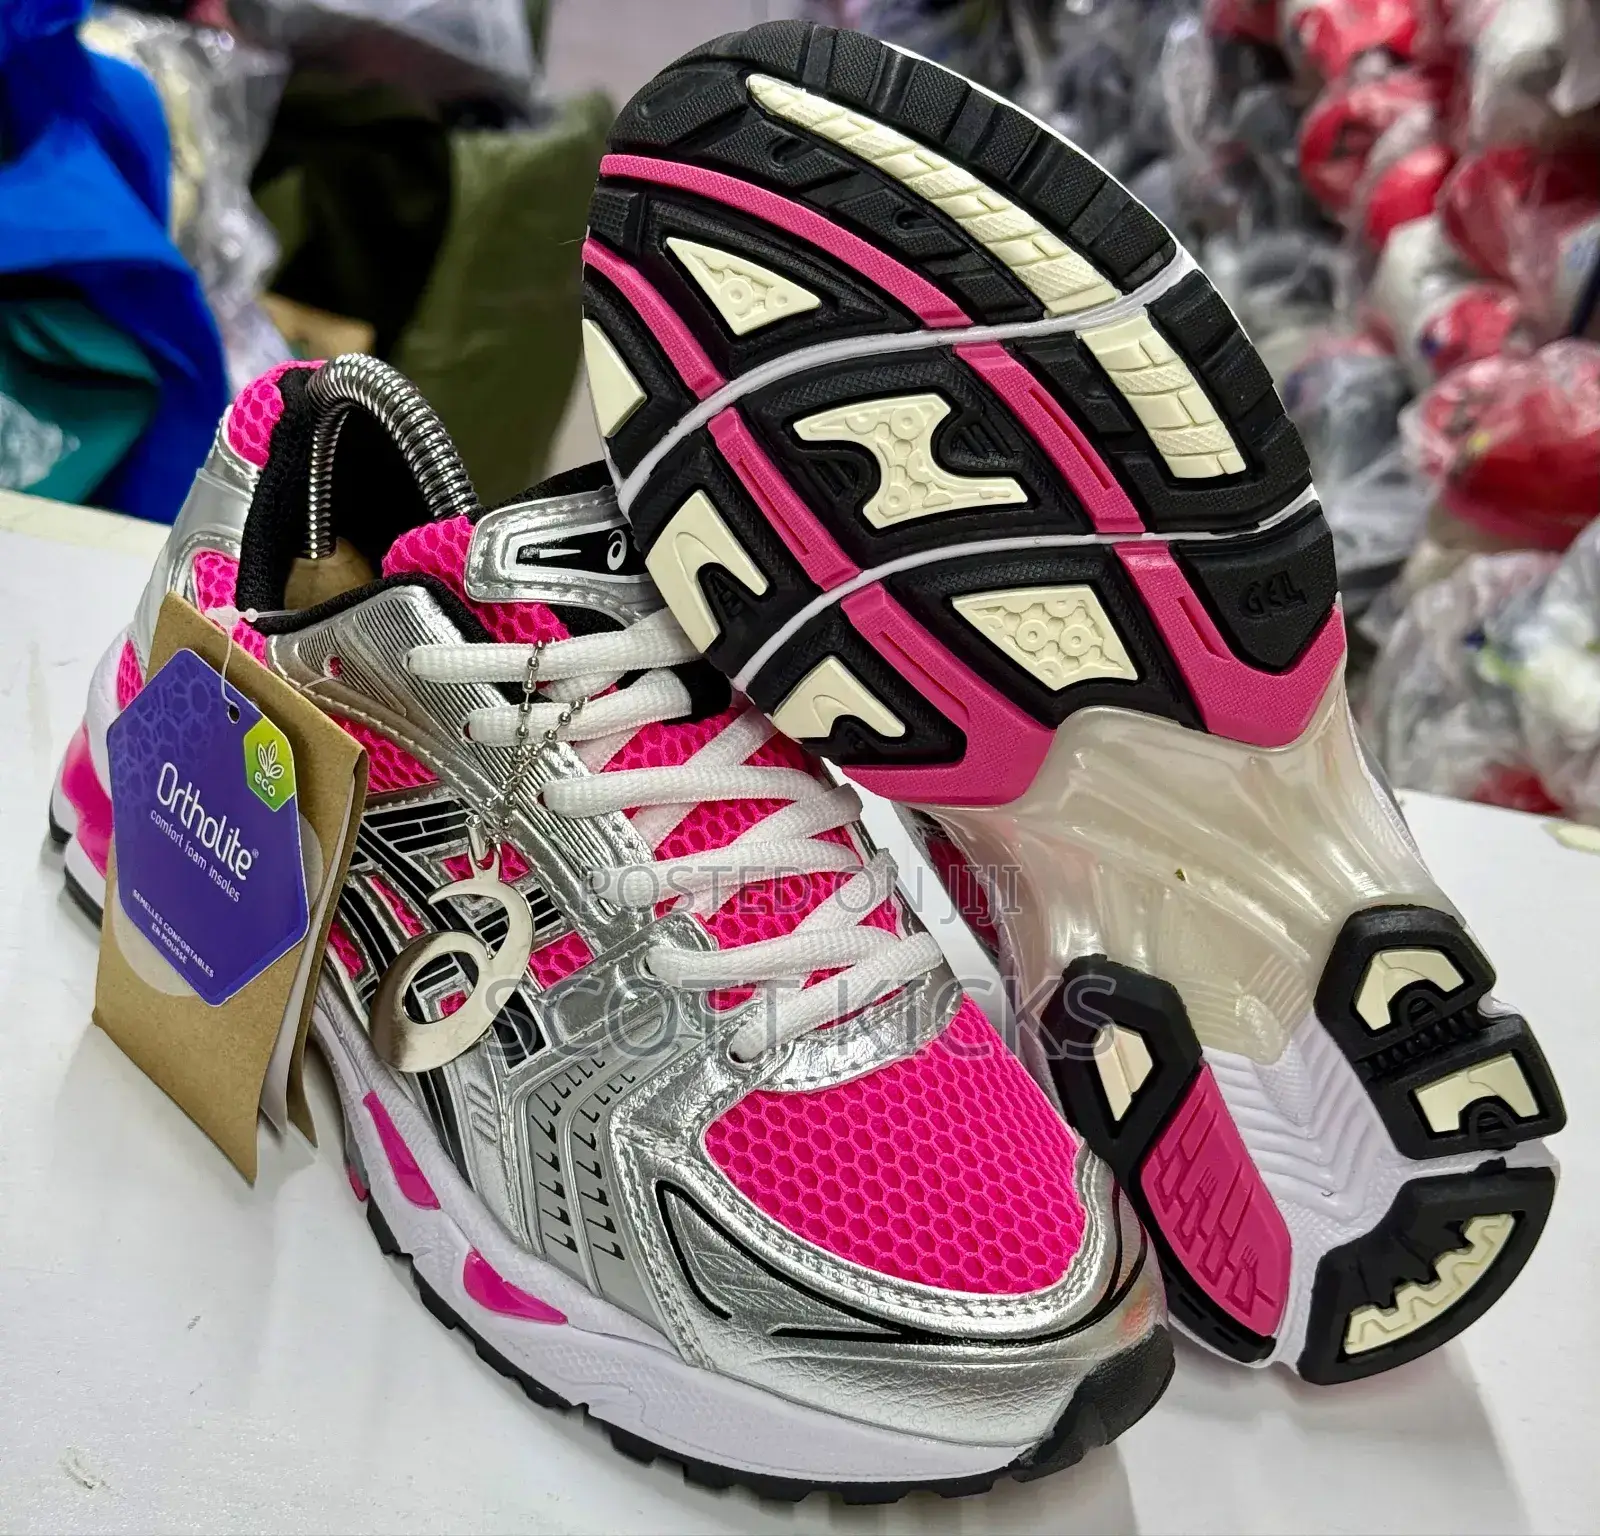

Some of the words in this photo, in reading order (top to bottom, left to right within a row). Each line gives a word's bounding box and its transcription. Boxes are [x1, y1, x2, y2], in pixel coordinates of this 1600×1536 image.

[254, 771, 275, 797] eco
[150, 809, 183, 848] comfort
[184, 840, 207, 870] foam
[208, 864, 241, 903] insoles
[132, 888, 163, 925] SEMELLES
[163, 922, 215, 978] CONFORTABLES
[151, 922, 161, 937] EN
[160, 933, 188, 965] MOUSSE
